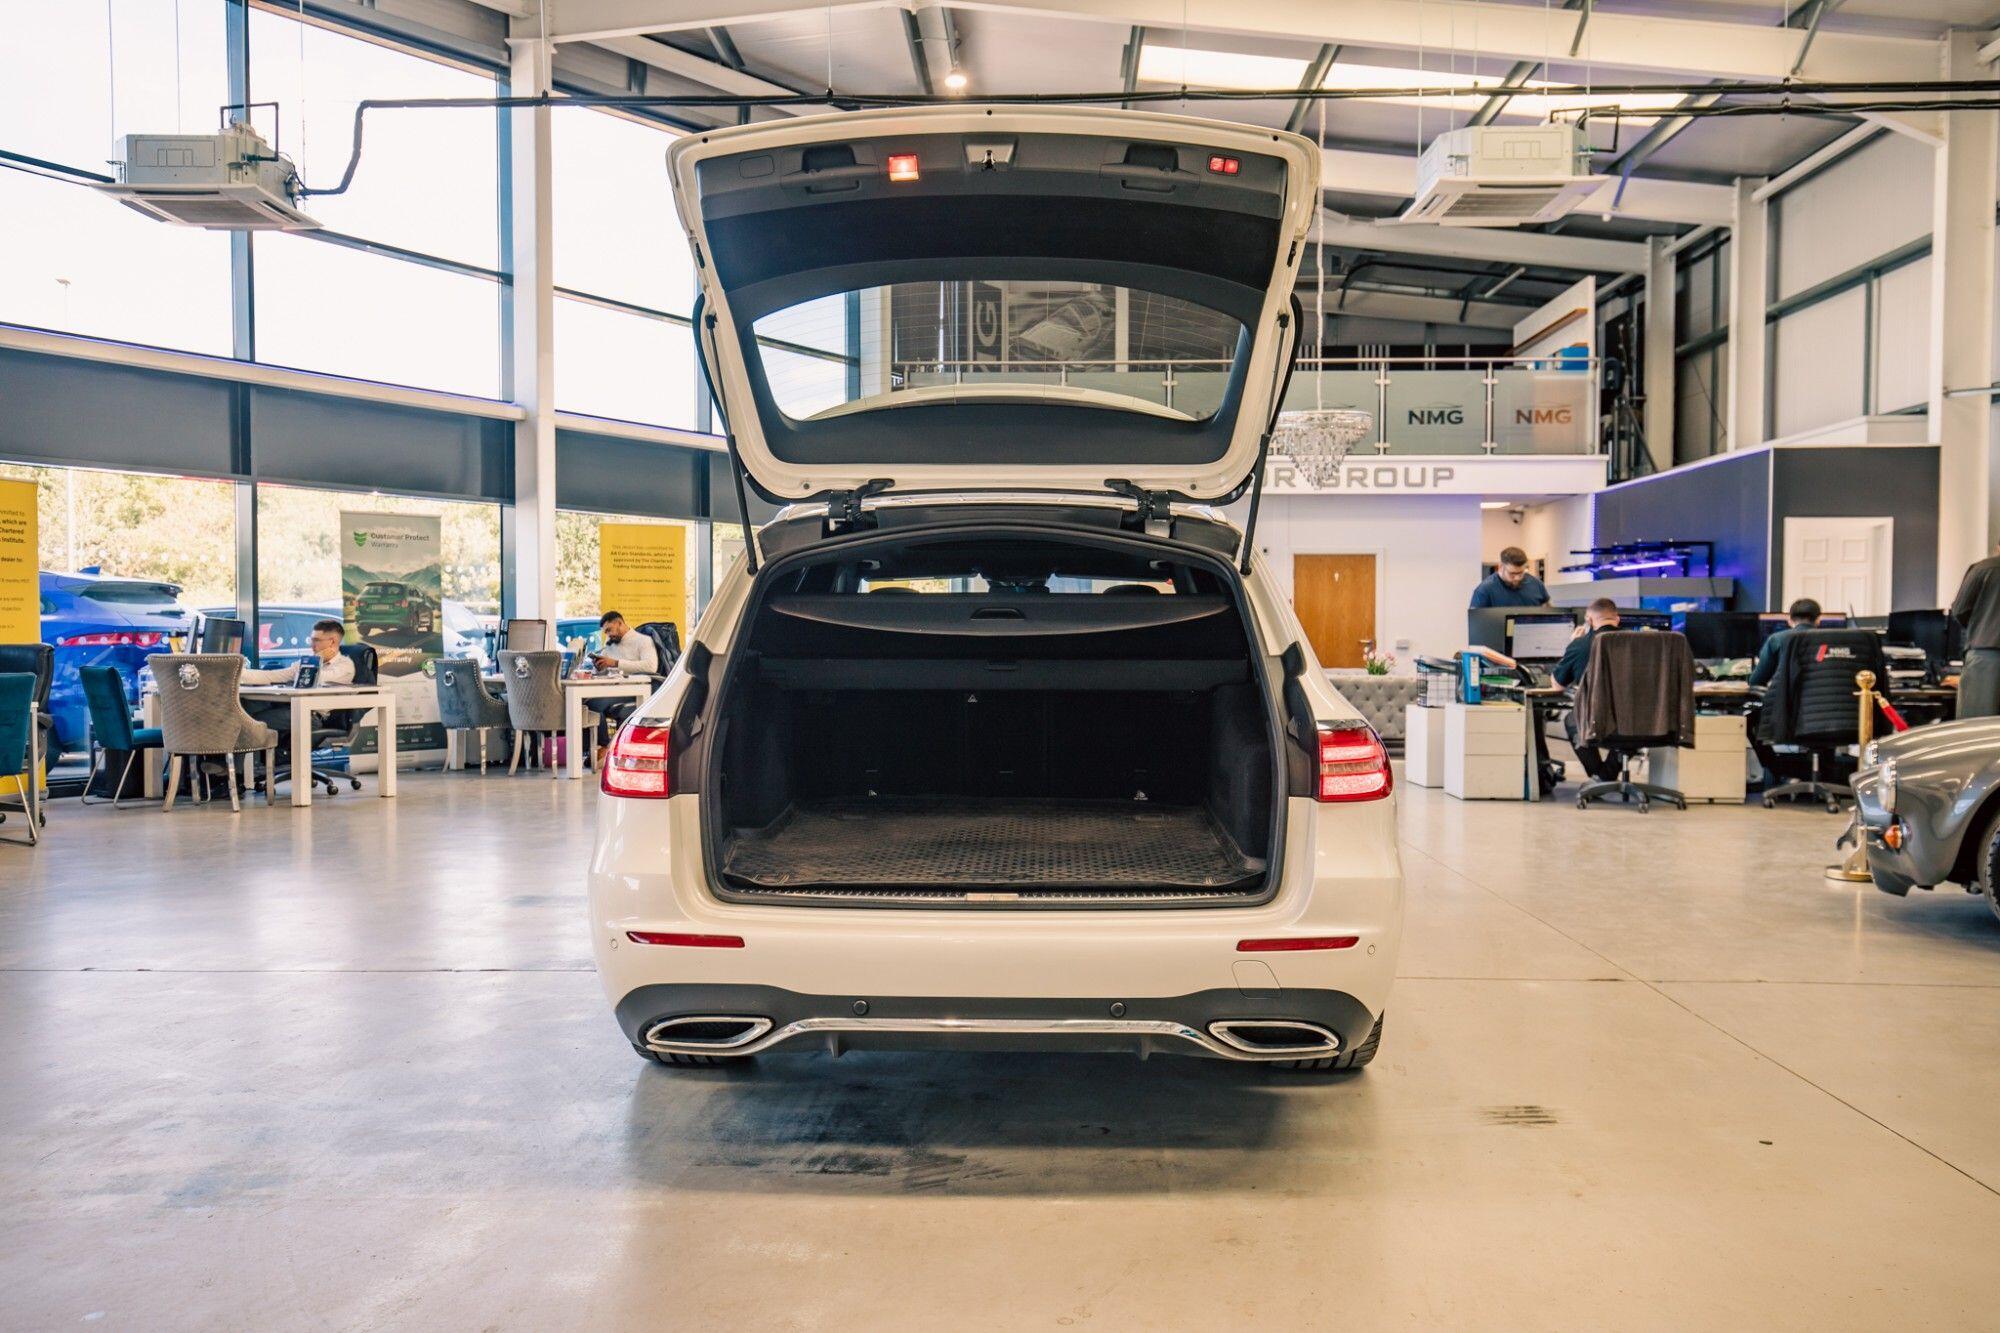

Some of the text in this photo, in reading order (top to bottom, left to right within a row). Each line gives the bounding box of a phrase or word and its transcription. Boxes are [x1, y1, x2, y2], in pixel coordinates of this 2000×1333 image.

[1408, 410, 1464, 425] NMG
[1515, 409, 1572, 425] NMG
[370, 532, 430, 541] Customer Protect
